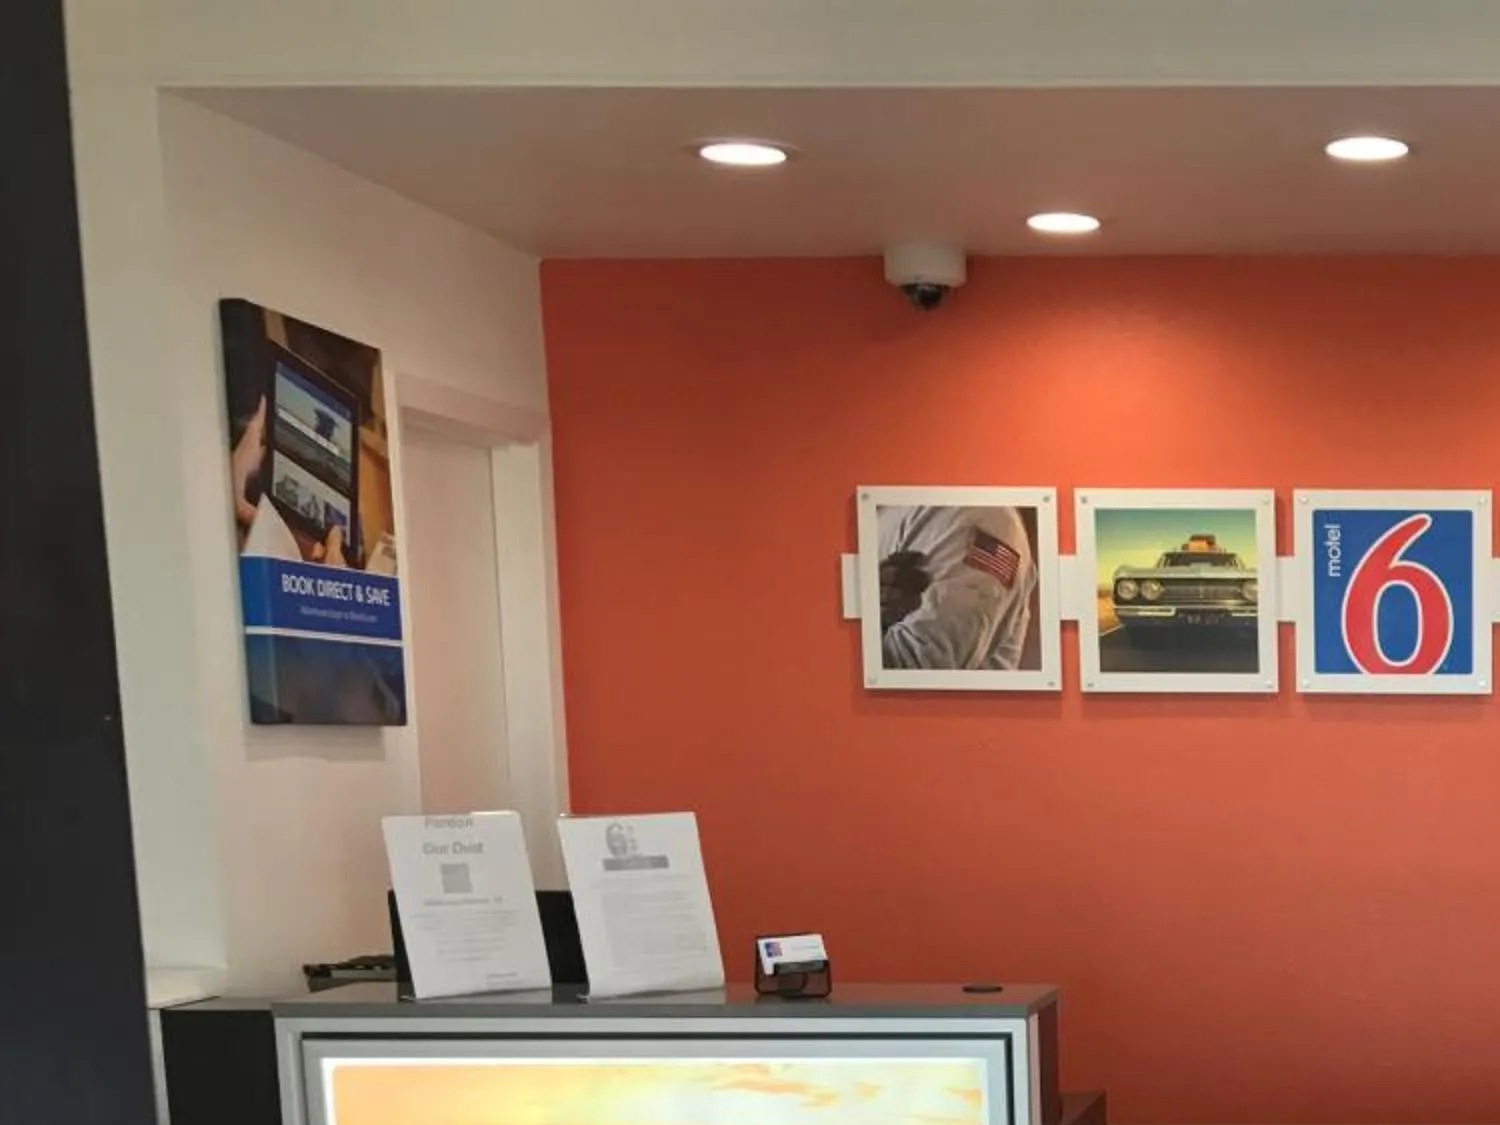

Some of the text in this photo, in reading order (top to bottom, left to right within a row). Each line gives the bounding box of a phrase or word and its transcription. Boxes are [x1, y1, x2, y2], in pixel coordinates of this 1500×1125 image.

[1324, 524, 1341, 577] motel
[281, 573, 315, 596] BOOK
[317, 579, 353, 601] DIRECT
[366, 585, 391, 607] SAVE
[1341, 513, 1454, 675] 6
